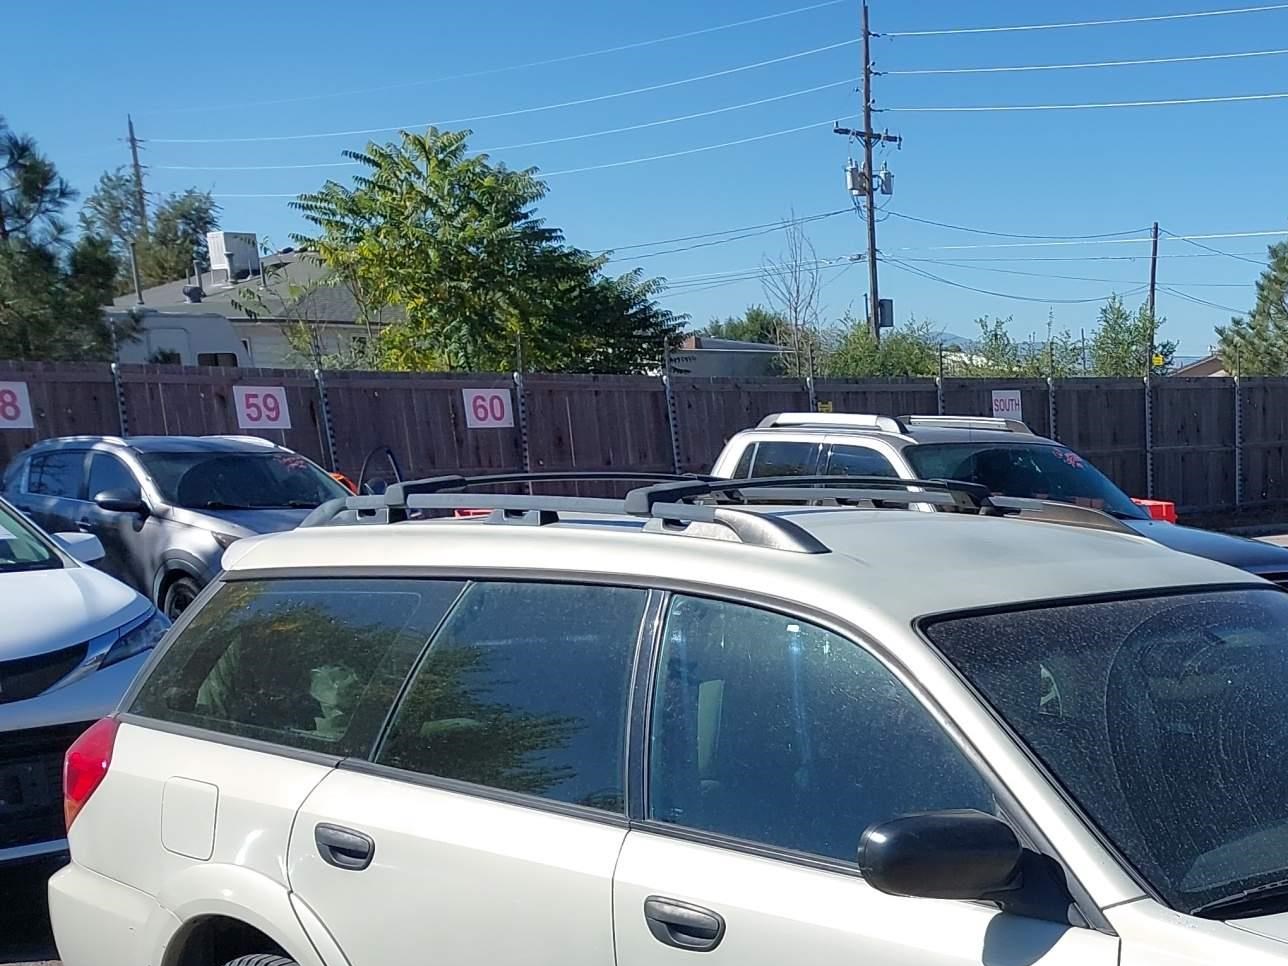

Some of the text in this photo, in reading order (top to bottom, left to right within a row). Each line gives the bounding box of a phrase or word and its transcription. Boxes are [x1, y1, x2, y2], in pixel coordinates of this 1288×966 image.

[244, 393, 280, 422] 59
[472, 395, 505, 422] 60
[994, 398, 1020, 412] SOUTH
